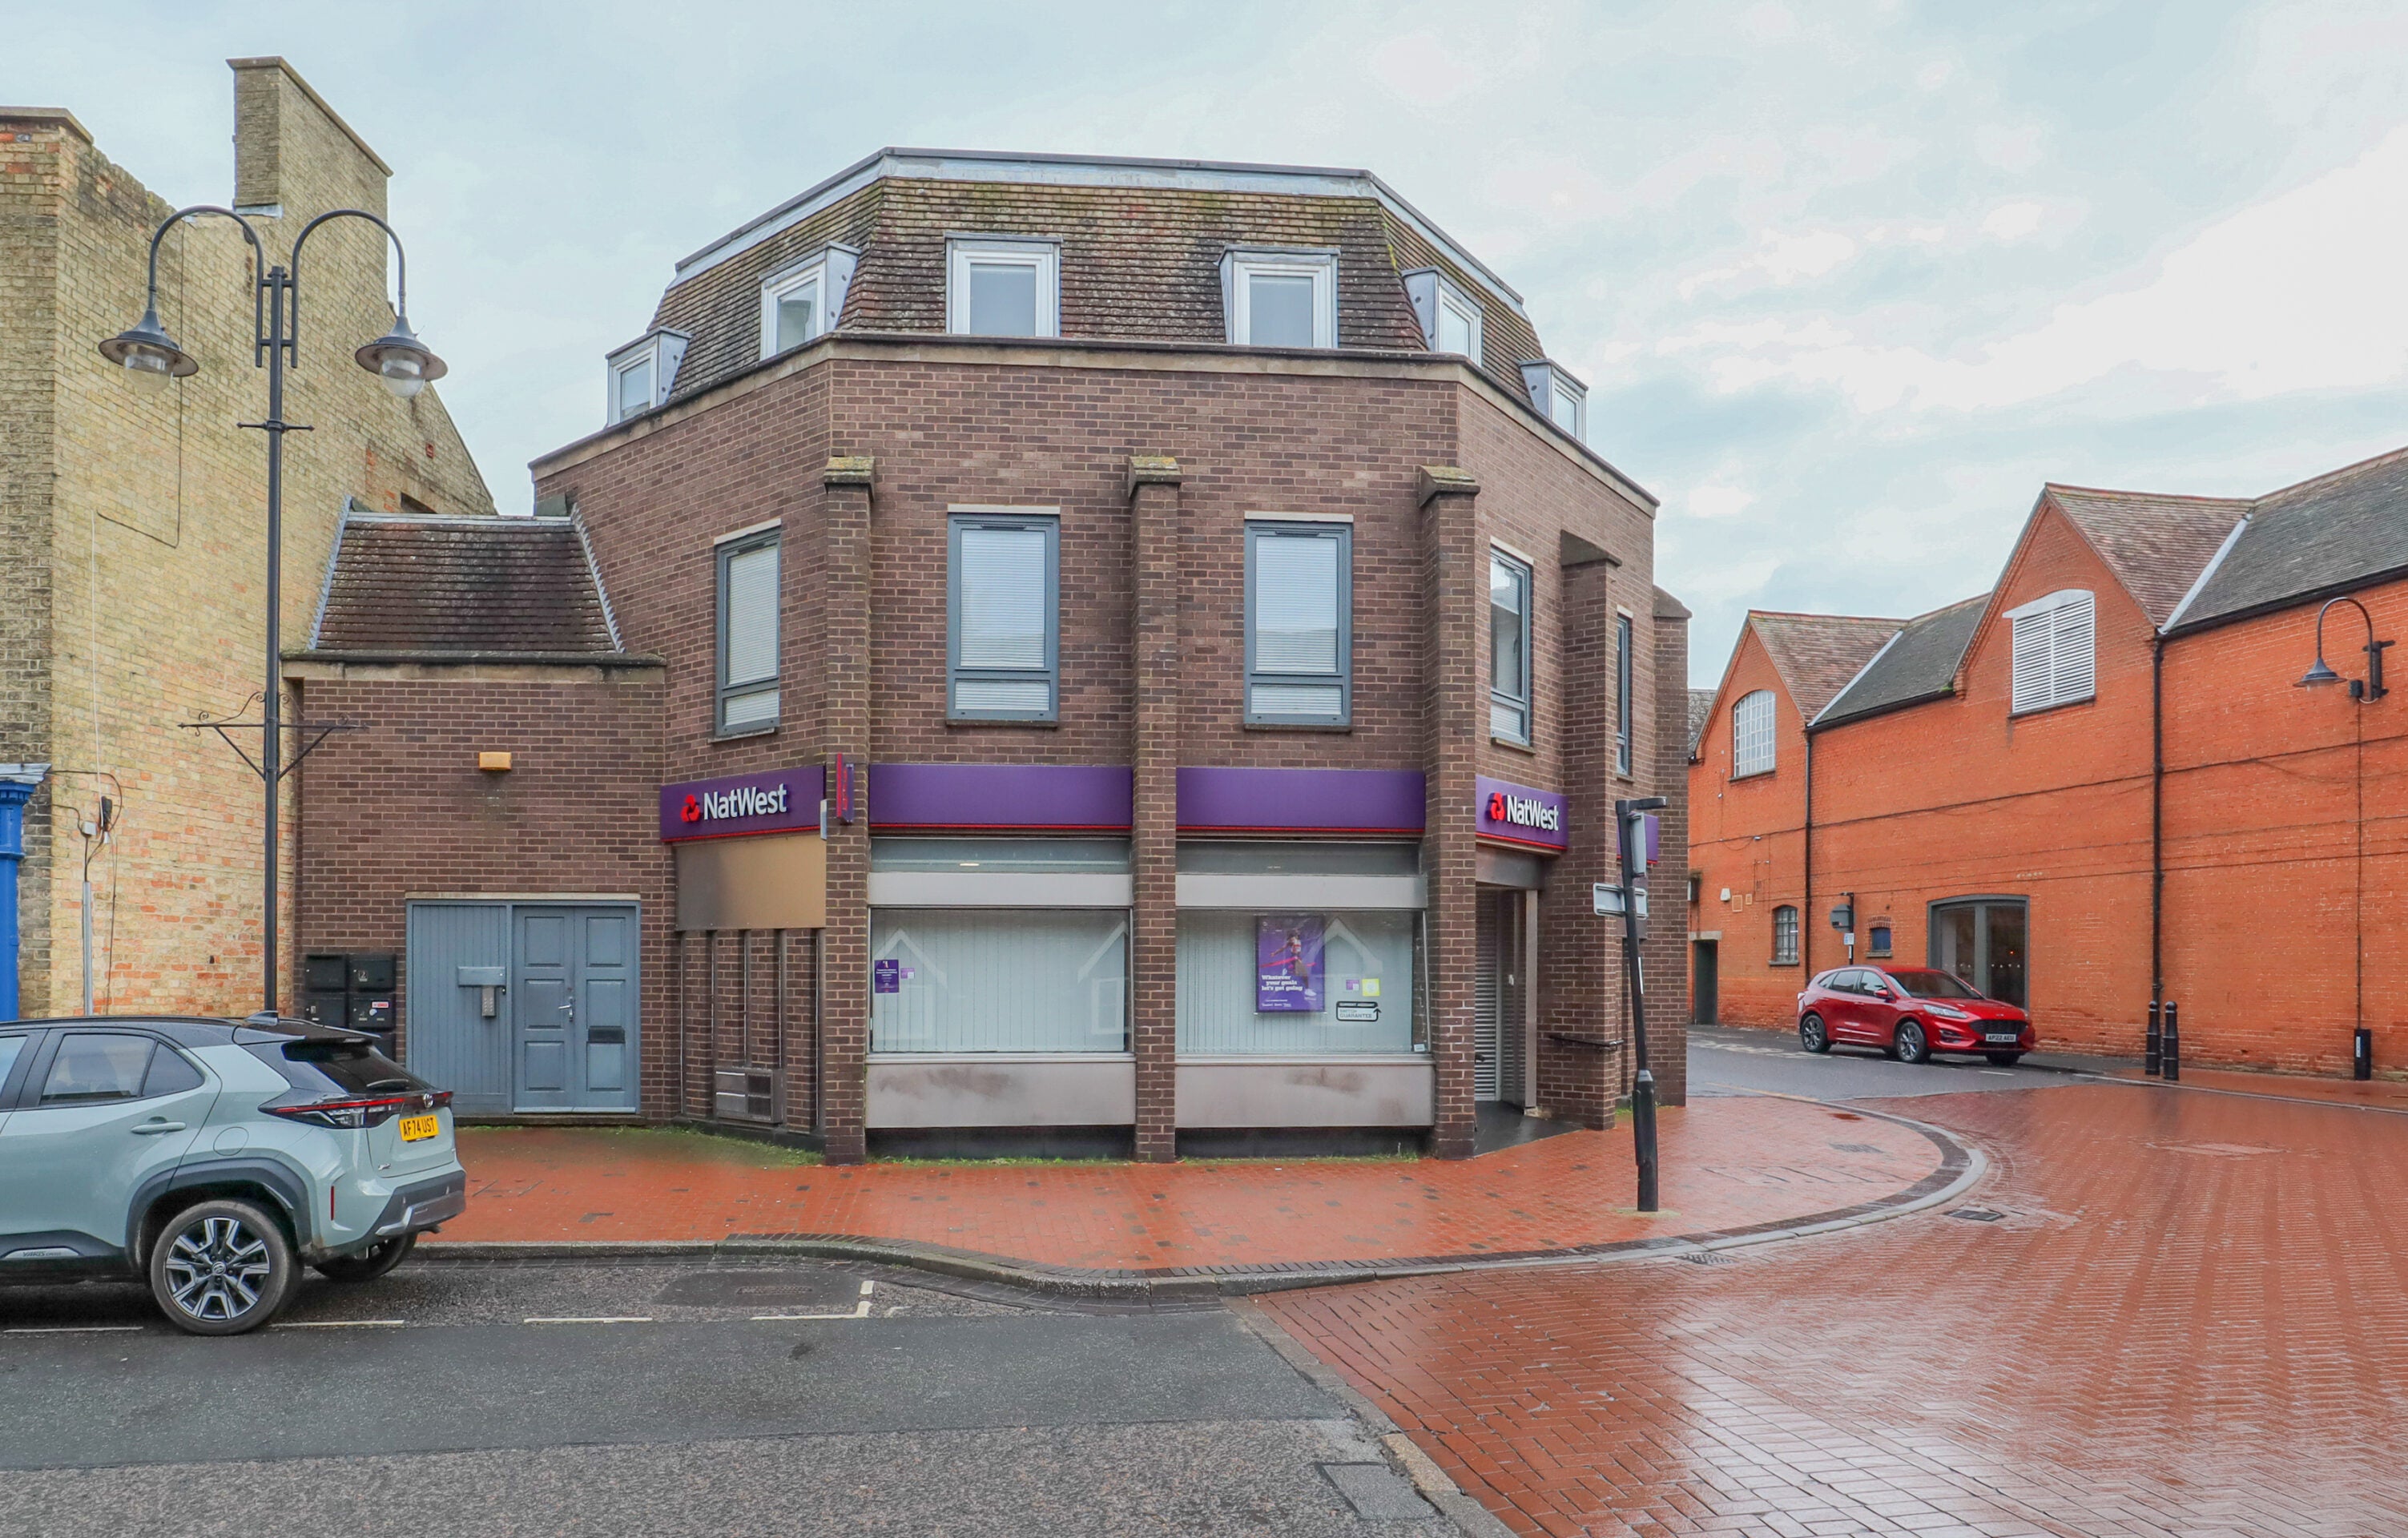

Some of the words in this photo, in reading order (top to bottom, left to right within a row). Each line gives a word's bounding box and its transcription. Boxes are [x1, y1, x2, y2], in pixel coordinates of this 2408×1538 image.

[704, 783, 787, 820] NatWest
[1507, 794, 1559, 831] NatWest
[403, 1120, 421, 1137] AF74
[421, 1117, 435, 1133] UST
